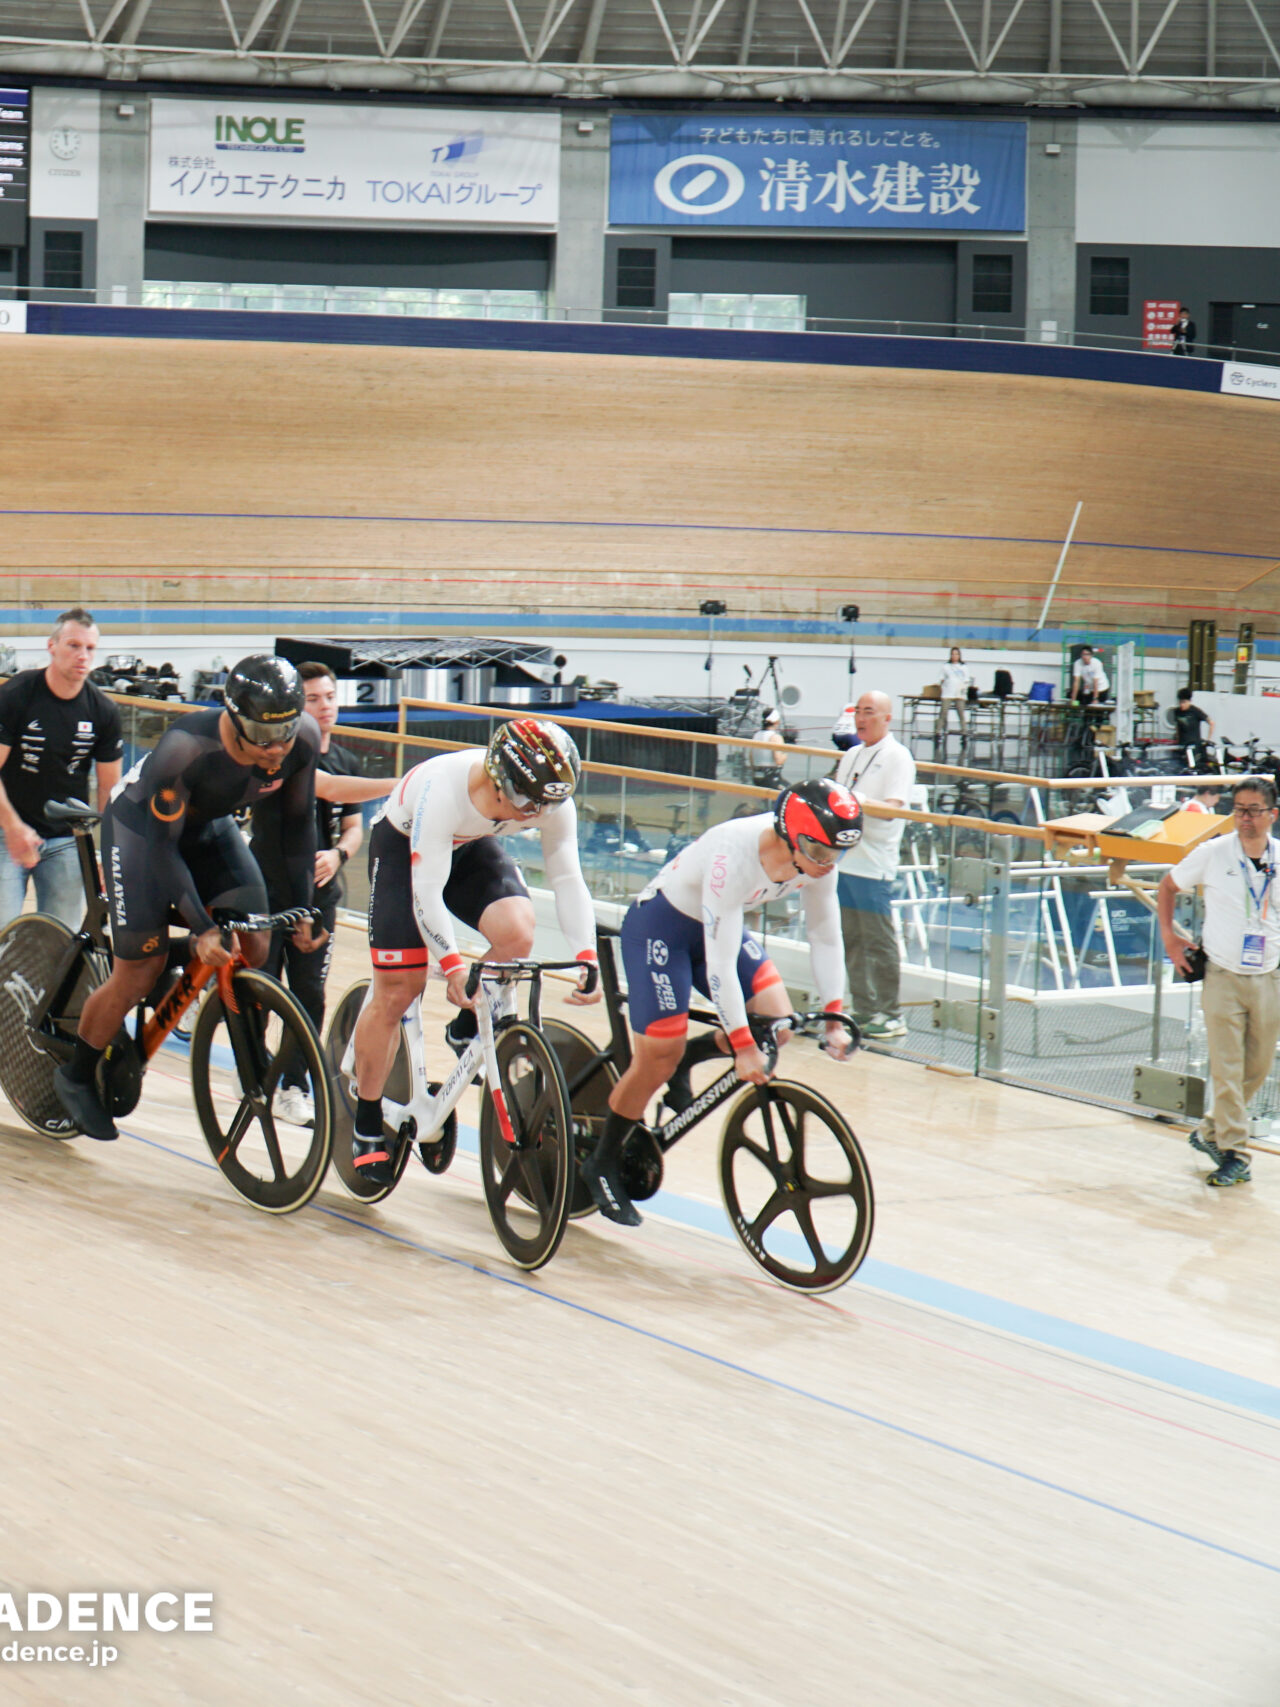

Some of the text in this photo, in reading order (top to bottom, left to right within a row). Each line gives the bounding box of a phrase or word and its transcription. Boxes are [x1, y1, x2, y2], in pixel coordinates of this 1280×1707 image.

[215, 115, 305, 144] INOUE
[699, 127, 941, 149] 子どもたちに誇れるしごとを。
[168, 156, 216, 169] 株式会社
[170, 171, 346, 201] イノウエテクニカ
[366, 179, 543, 206] TOKAIグループ
[758, 157, 982, 216] 清水建設
[356, 683, 375, 703] 2
[451, 673, 465, 701] 1
[540, 690, 552, 701] 3
[503, 743, 537, 783] Kabuto
[111, 846, 127, 926] MALAYSIA
[651, 971, 677, 1010] SPEED
